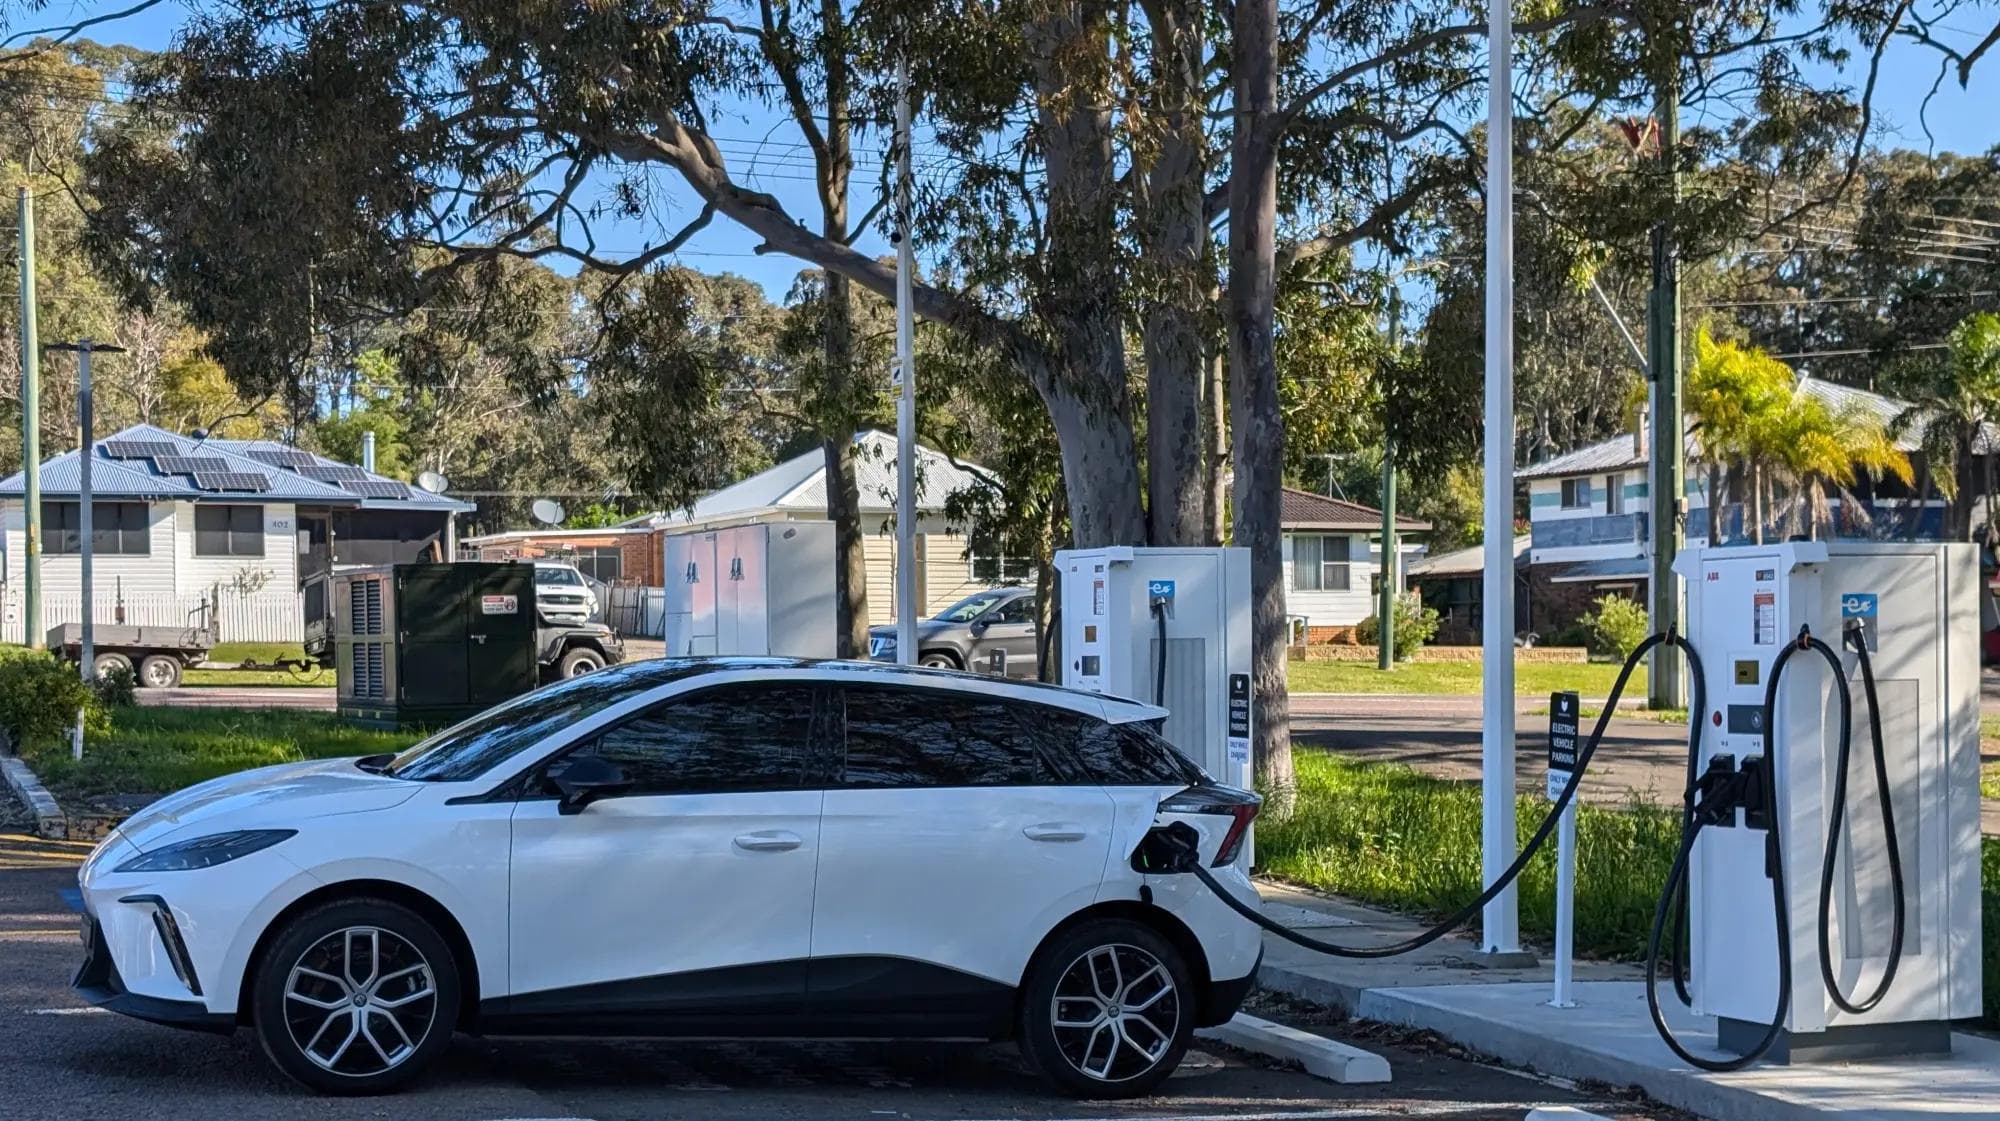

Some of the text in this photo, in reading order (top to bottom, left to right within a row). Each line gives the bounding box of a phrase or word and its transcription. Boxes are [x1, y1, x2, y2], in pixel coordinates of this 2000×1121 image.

[1552, 723, 1576, 735] ELECTRIC
[1553, 738, 1574, 749] VEHICLE
[1552, 752, 1575, 764] PARKING
